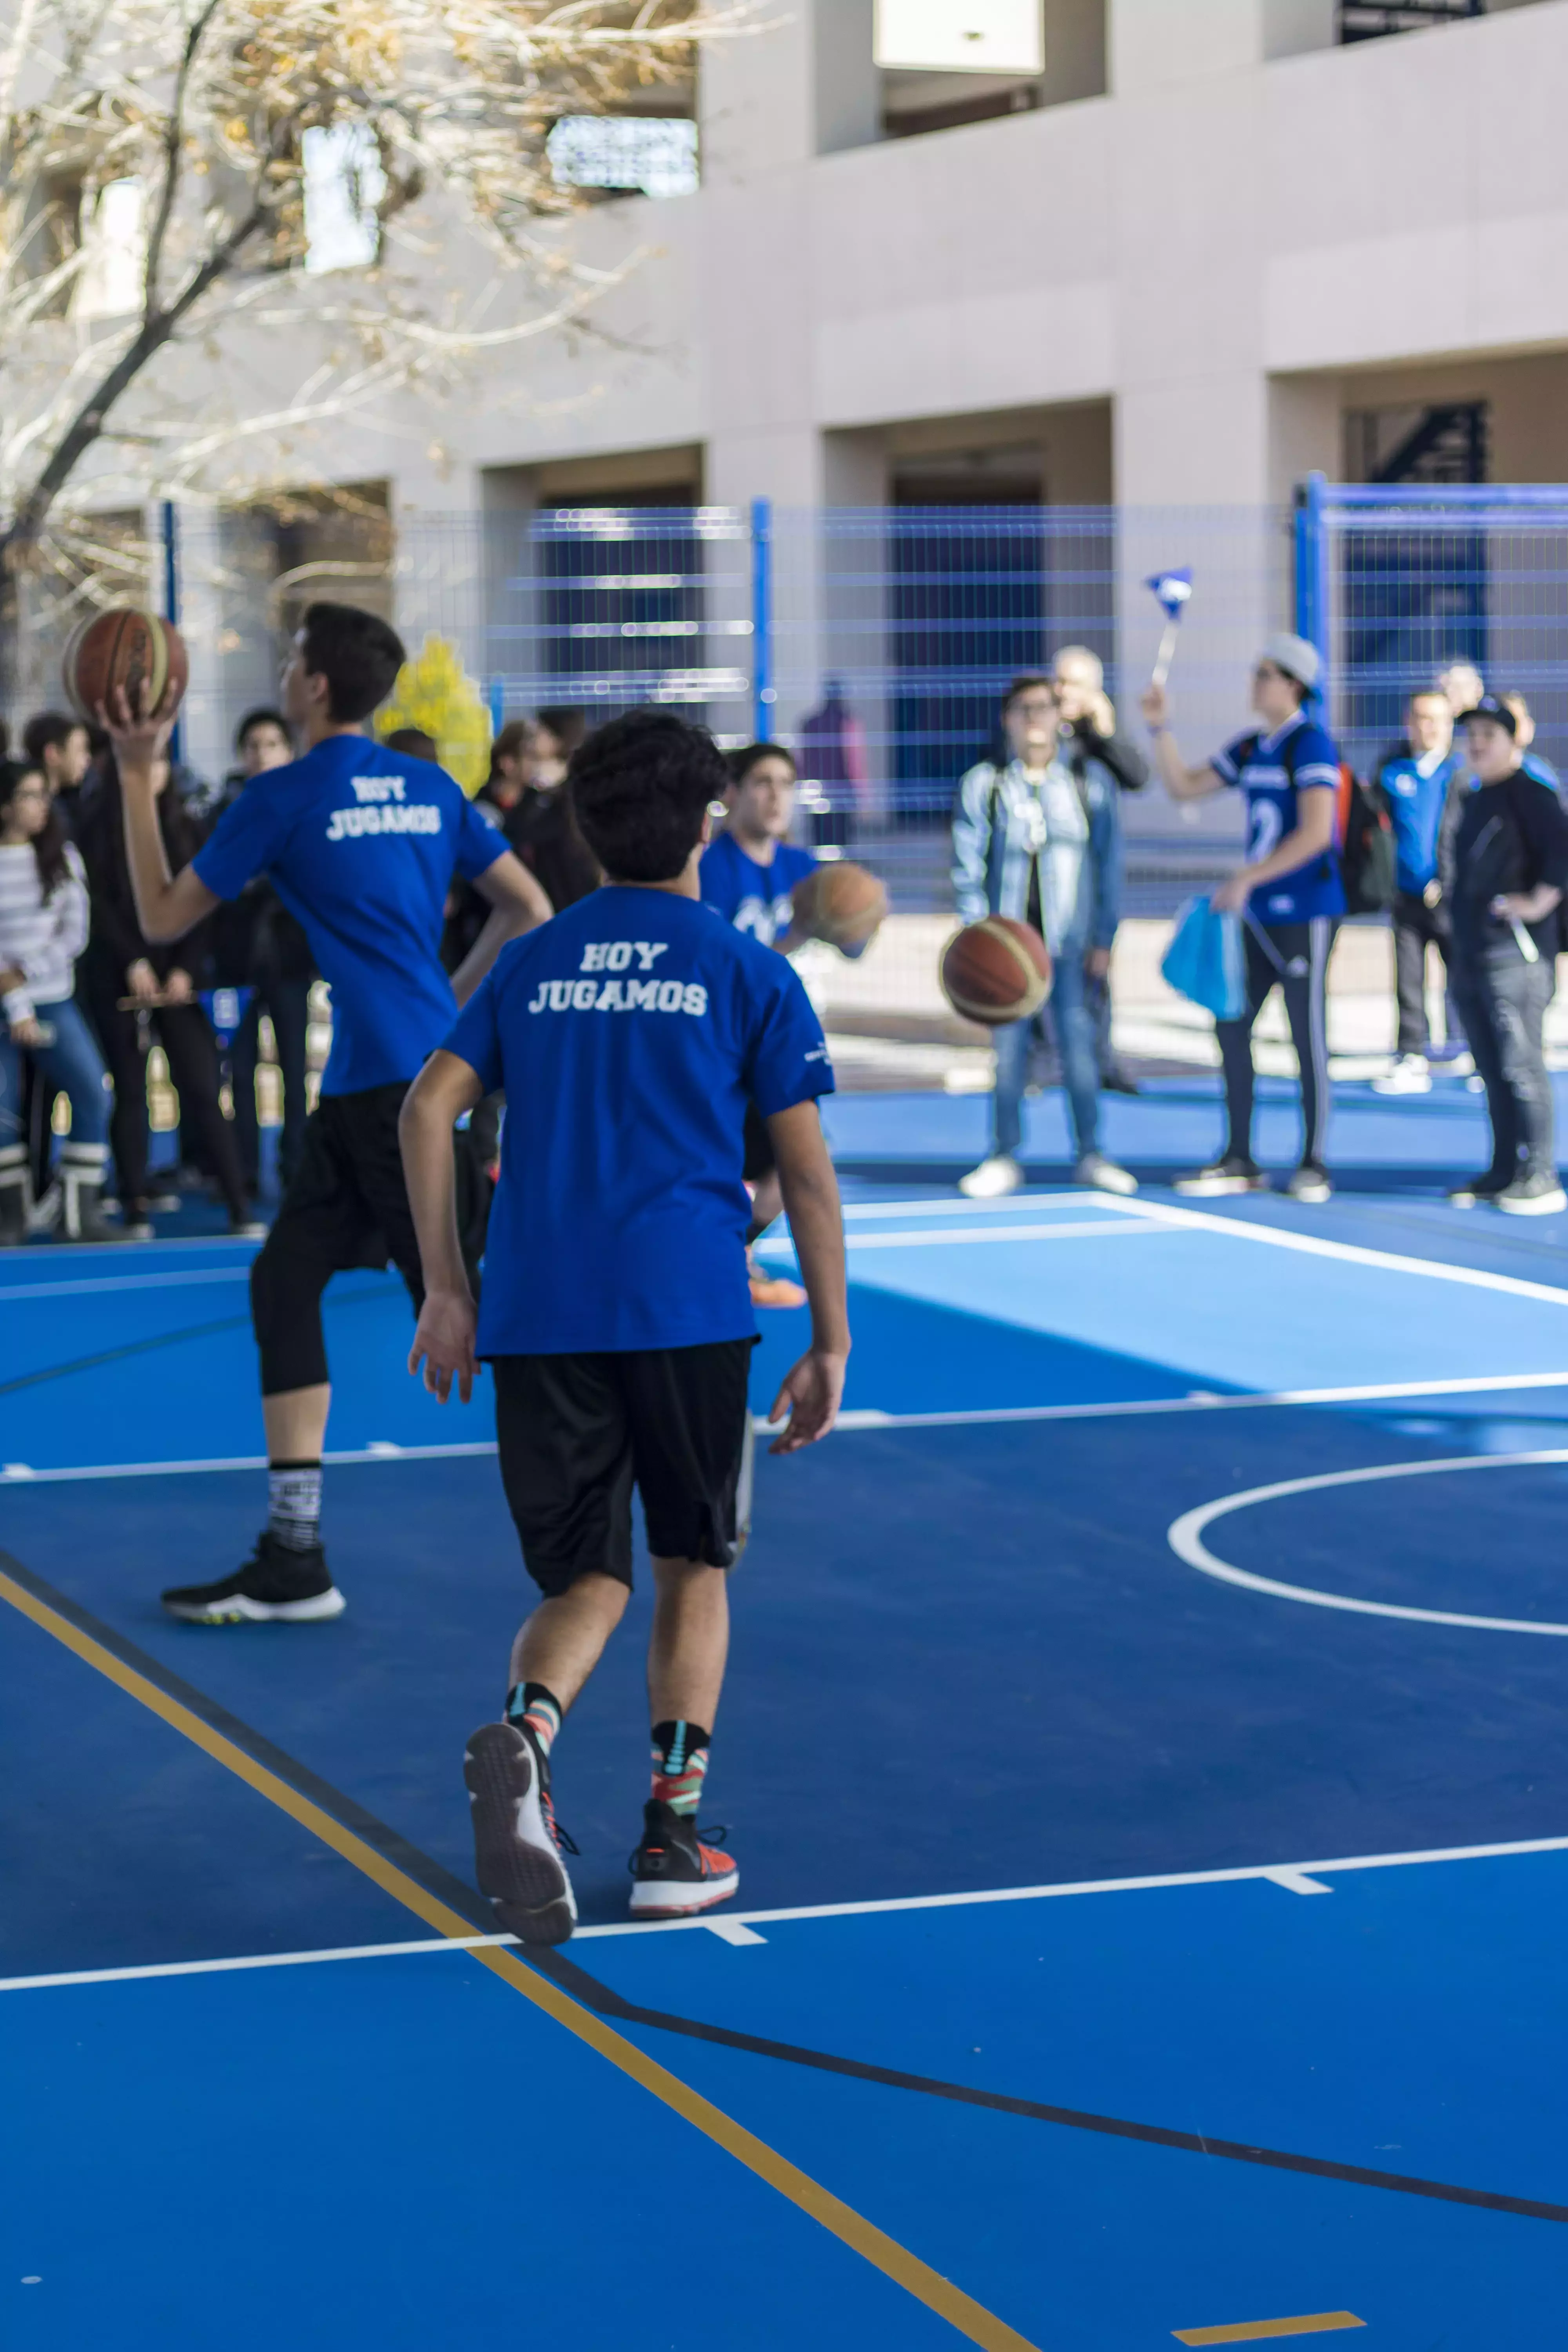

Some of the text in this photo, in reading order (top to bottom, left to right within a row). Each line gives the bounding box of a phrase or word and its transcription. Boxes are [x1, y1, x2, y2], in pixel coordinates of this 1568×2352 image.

[351, 777, 405, 802] HOY
[327, 805, 441, 840] JUGAMOS
[580, 942, 668, 971] HOY
[528, 979, 707, 1017] JUGAMOS
